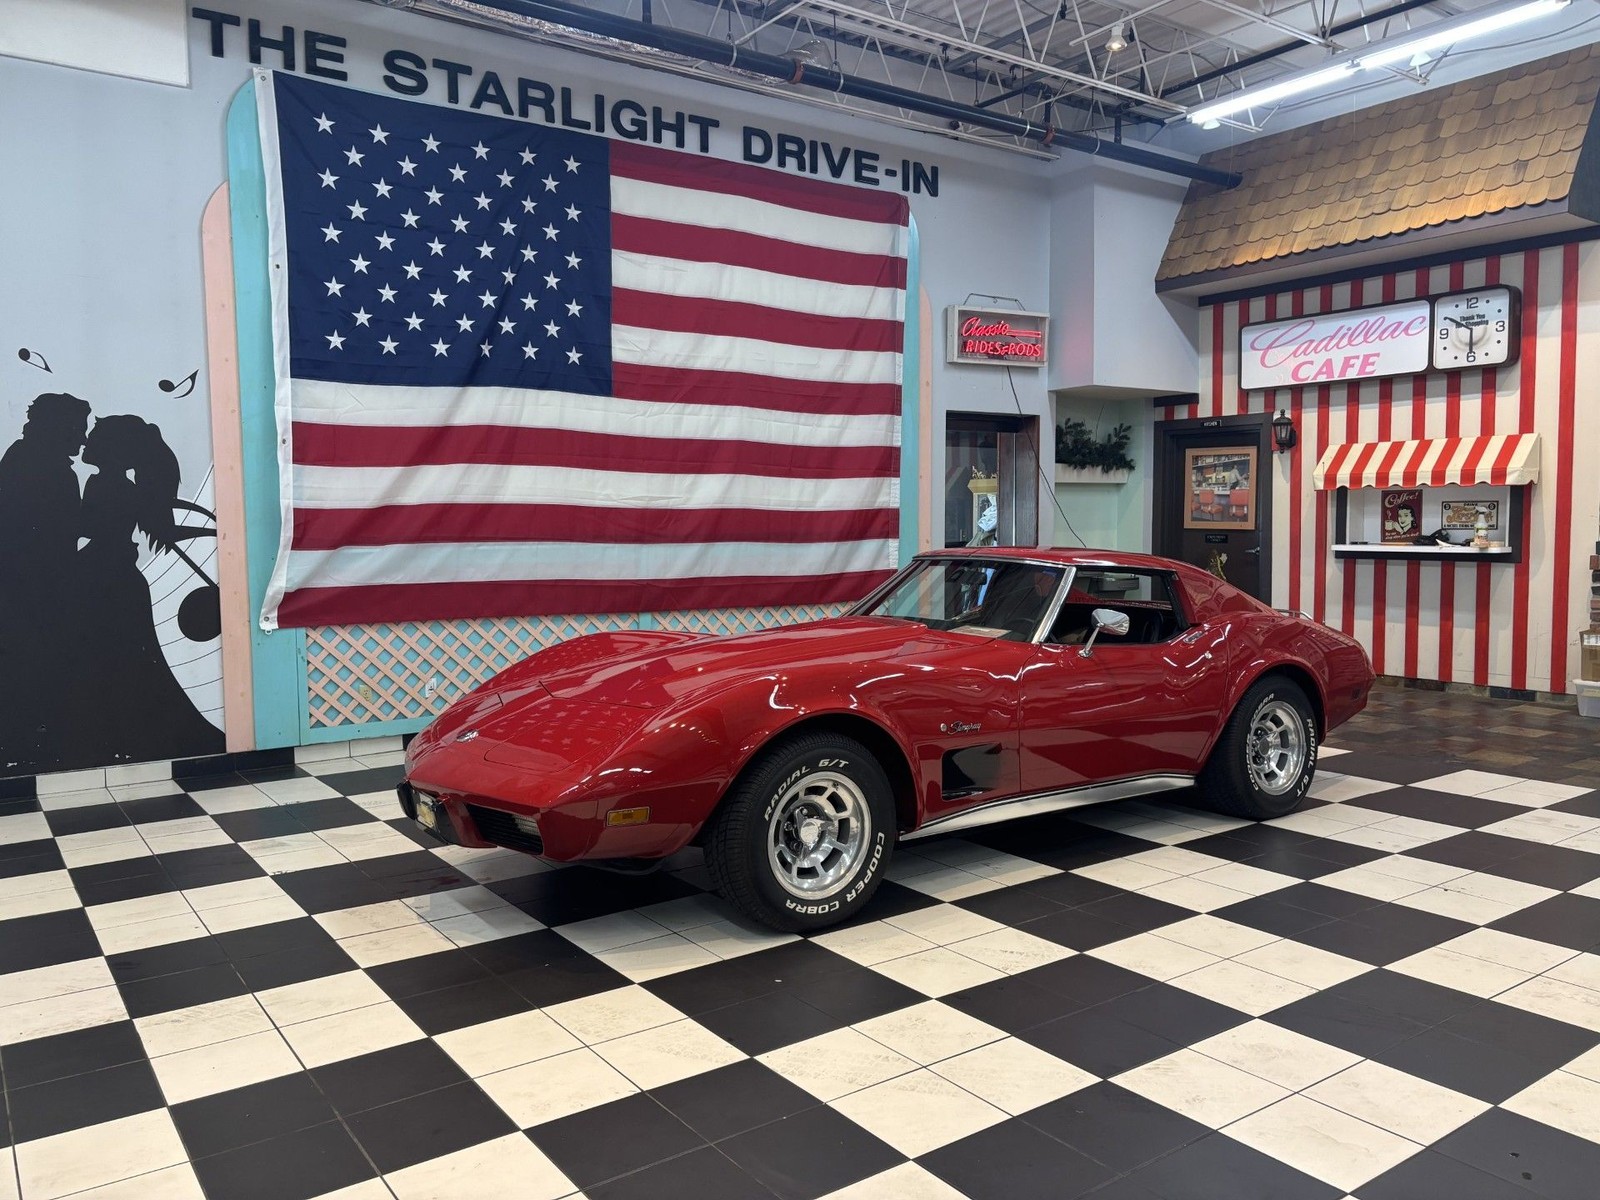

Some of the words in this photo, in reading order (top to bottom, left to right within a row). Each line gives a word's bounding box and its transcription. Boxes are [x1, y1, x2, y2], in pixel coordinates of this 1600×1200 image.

[192, 7, 348, 82] THE
[382, 49, 720, 153] STARLIGHT
[743, 126, 939, 197] DRIVE-IN
[1466, 297, 1479, 309] 12
[1460, 314, 1475, 322] Thank
[1465, 319, 1489, 327] Shopping
[1495, 320, 1506, 332] 3
[963, 317, 1010, 337] Classic
[1439, 328, 1449, 339] 9
[966, 340, 1000, 354] RIDES
[1008, 343, 1042, 357] RODS
[1250, 316, 1427, 369] Cadillac
[1466, 350, 1476, 362] 6
[1291, 352, 1380, 382] CAFE
[1385, 492, 1419, 508] Coffee!
[1307, 718, 1316, 768] RADIAL
[764, 765, 810, 821] RADIAL
[818, 758, 849, 768] G/T
[1297, 775, 1309, 797] G/T
[846, 831, 885, 902] COOPER
[785, 899, 840, 915] COBRA
